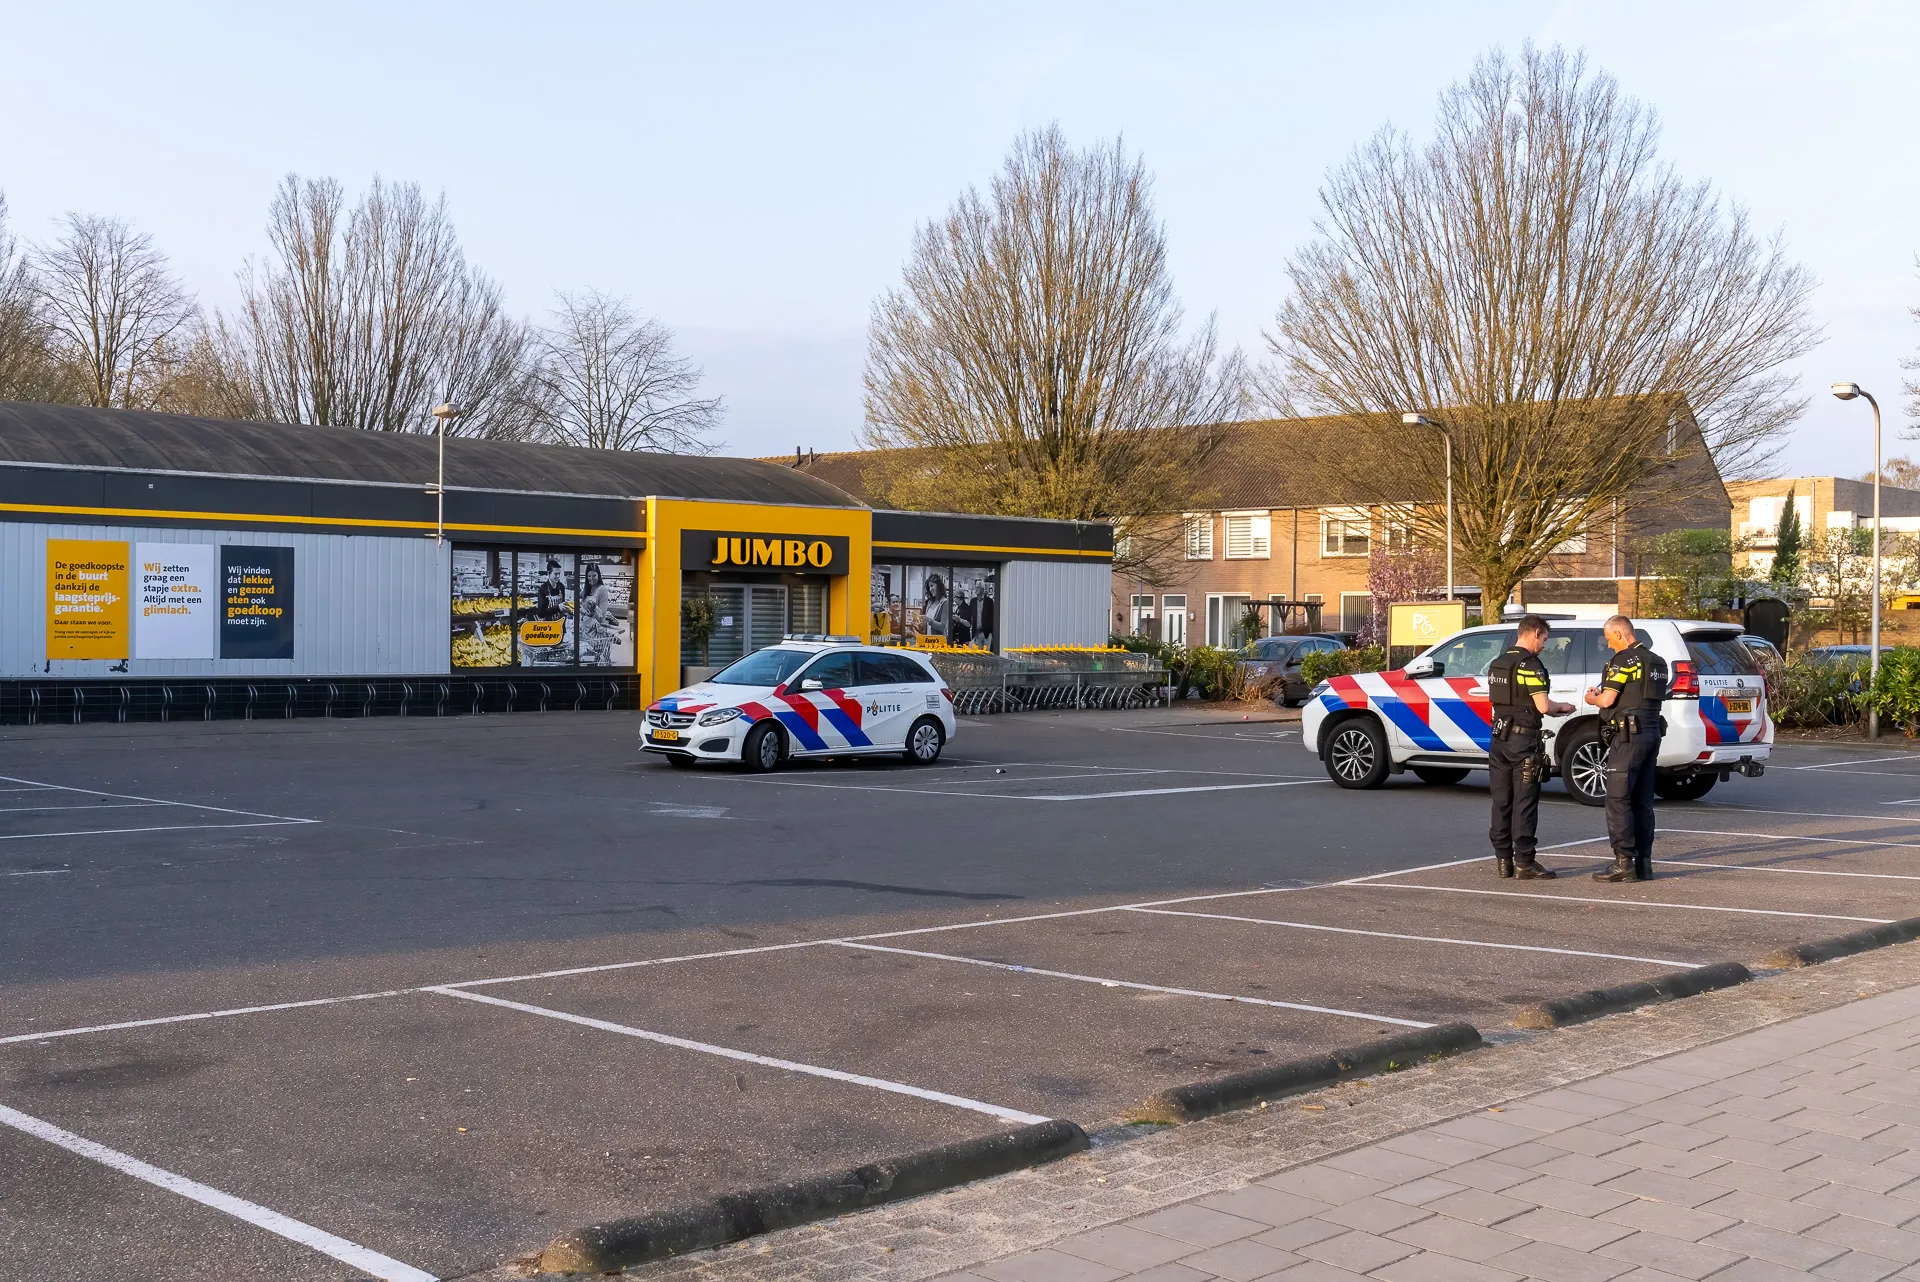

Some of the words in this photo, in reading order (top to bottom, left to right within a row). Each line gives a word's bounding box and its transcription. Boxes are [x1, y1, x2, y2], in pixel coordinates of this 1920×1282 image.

[712, 537, 833, 568] JUMBO
[55, 561, 67, 569] De
[69, 562, 125, 572] goedkoopste
[144, 562, 161, 574] Wij
[227, 566, 242, 575] Wij
[243, 566, 271, 574] vinden
[55, 572, 64, 580] in
[65, 572, 77, 580] de
[79, 571, 108, 580] buurt
[143, 575, 168, 583] graag
[227, 576, 242, 584] dat
[242, 575, 273, 584] lekker
[55, 582, 87, 593] dankzij
[89, 583, 100, 591] de
[143, 584, 169, 594] stapje
[171, 583, 202, 592] extra.
[239, 585, 275, 596] gezond
[55, 592, 121, 605] laagsteprijs-
[143, 595, 166, 605] Altijd
[227, 595, 249, 604] eten
[250, 596, 266, 604] ook
[55, 603, 104, 615] garantie.
[143, 604, 192, 616] glimlach.
[227, 604, 283, 618] goedkoop
[250, 617, 267, 627] zijn.
[532, 624, 553, 632] Euro's
[524, 631, 560, 640] goedkoper
[866, 701, 901, 716] POLITIE
